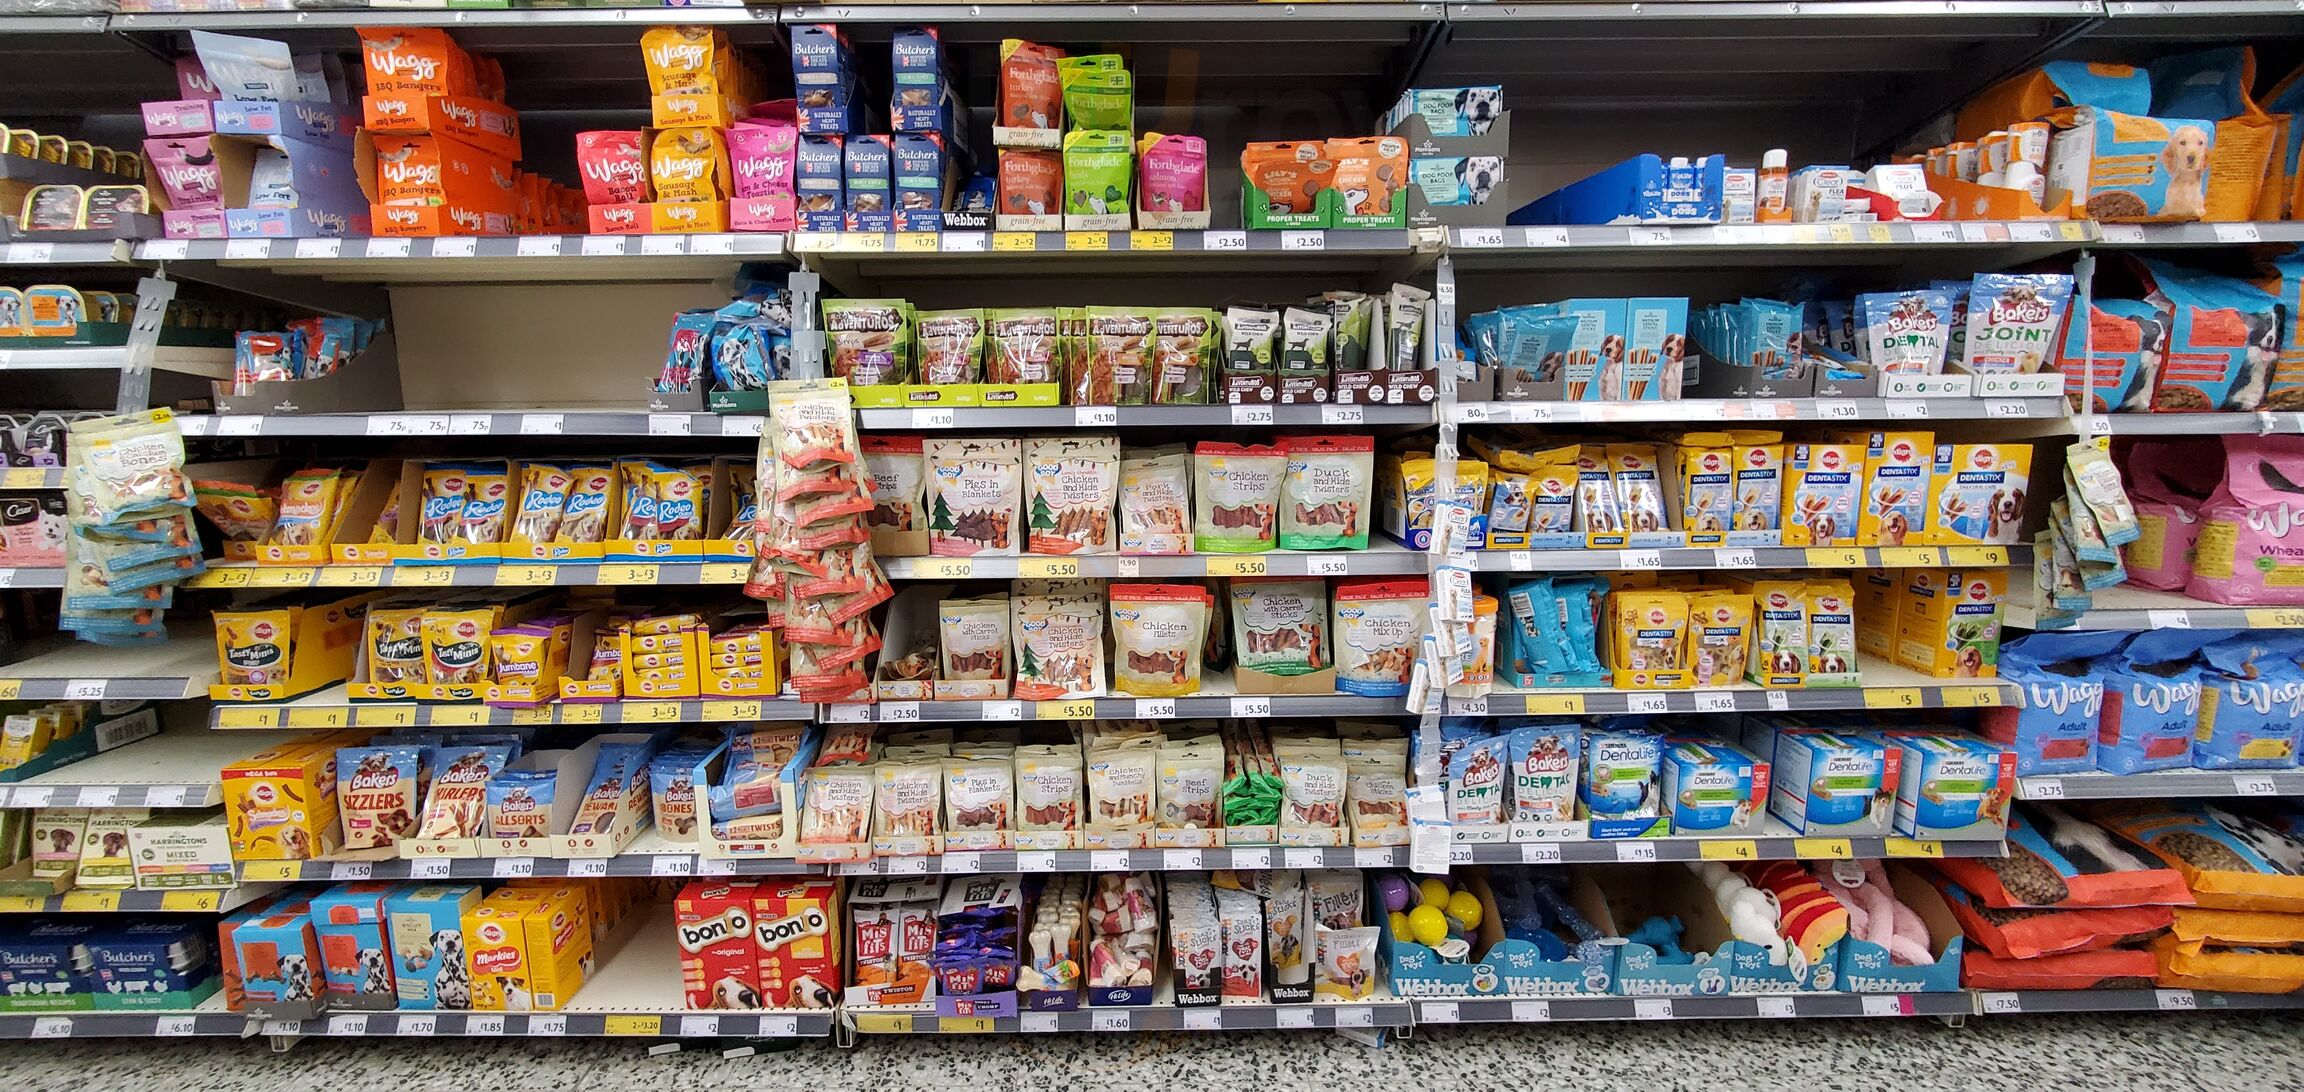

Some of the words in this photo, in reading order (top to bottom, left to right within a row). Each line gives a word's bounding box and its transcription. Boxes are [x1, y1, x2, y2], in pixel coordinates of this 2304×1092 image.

[795, 45, 836, 55] Butcher's
[896, 45, 935, 56] Butcher's
[650, 45, 708, 69] Wagg
[371, 51, 441, 80] Wagg
[662, 72, 696, 83] Sausage
[397, 82, 442, 92] Bangers
[377, 100, 407, 115] Wagg
[667, 99, 698, 114] Wagg
[295, 105, 336, 131] Wagg
[441, 99, 478, 127] Wagg
[147, 111, 177, 127] Wagg
[1008, 130, 1044, 140] grain-free
[800, 152, 839, 163] Butcher's
[848, 152, 888, 162] Butcher's
[898, 150, 938, 160] Butcher's
[1069, 155, 1123, 168] Forthglade
[1149, 158, 1201, 174] Forthglade
[586, 157, 644, 184] Wagg
[652, 156, 708, 180] Wagg
[738, 156, 788, 180] Wagg
[163, 166, 216, 192] Wagg
[608, 187, 637, 195] Bacon
[658, 182, 695, 191] Sausage
[667, 207, 698, 223] Wagg
[749, 203, 775, 217] Wagg
[388, 209, 419, 224] Wagg
[450, 207, 482, 231] Wagg
[603, 208, 635, 224] Wagg
[944, 213, 986, 227] Webbox
[1010, 217, 1047, 226] grain-free
[1082, 217, 1119, 226] grain-free
[1157, 215, 1194, 225] grain-free
[1267, 215, 1292, 223] PROPER
[861, 238, 882, 247] £1.75
[1219, 237, 1245, 247] £2.50
[1477, 235, 1501, 245] £1.65
[1652, 232, 1670, 243] 75p
[1991, 305, 2050, 322] Bakers
[1890, 316, 1937, 331] Bakers
[1467, 409, 1485, 418] 80p
[1833, 407, 1855, 417] £1.30
[2000, 405, 2025, 416] £2.20
[931, 415, 951, 425] £1.10
[1247, 412, 1271, 422] £2.75
[1229, 470, 1269, 481] Chicken
[1314, 468, 1350, 478] Duck
[1738, 470, 1775, 479] DENTASTIX
[1881, 467, 1919, 476] DENTASTIX
[874, 474, 899, 483] Beef
[1062, 476, 1099, 484] Chicken
[1693, 475, 1729, 483] DENTASTIX
[1808, 474, 1850, 483] DENTASTIX
[1960, 473, 2003, 482] DENTASTIX
[965, 480, 988, 491] Pigs
[989, 480, 999, 489] in
[1079, 483, 1098, 491] Hide
[1233, 482, 1265, 491] Strips
[1314, 485, 1350, 493] Twisters
[962, 489, 1001, 499] Blankets
[1063, 491, 1100, 500] Twisters
[527, 491, 562, 511] Rodeo
[566, 493, 604, 513] Rodeo
[659, 502, 691, 521] Rodeo
[1637, 557, 1660, 567] £1.65
[1733, 555, 1755, 566] £1.65
[1845, 554, 1856, 565] £5
[1986, 552, 1998, 563] £9
[941, 566, 970, 577] £5.50
[1047, 564, 1076, 575] £5.50
[1236, 562, 1265, 574] £5.50
[1322, 562, 1346, 573] £5.50
[1263, 597, 1301, 607] Chicken
[1279, 604, 1304, 613] Carrot
[1957, 605, 1993, 614] DENTASTIX
[1364, 619, 1411, 629] Chicken
[1813, 615, 1849, 624] DENTASTIX
[964, 622, 996, 630] Chicken
[1143, 622, 1187, 632] Chicken
[1705, 627, 1741, 636] DENTASTIX
[1048, 628, 1084, 636] Chicken
[1153, 630, 1176, 638] Fillets
[1373, 626, 1389, 636] Mix
[1390, 628, 1403, 638] Up
[1640, 630, 1674, 639] DENTASTIX
[78, 686, 101, 698] £5.25
[1643, 699, 1665, 711] £1.65
[1711, 697, 1733, 709] £1.65
[2031, 681, 2103, 718] Wagg
[893, 708, 918, 720] £2.50
[1064, 705, 1092, 717] £5.50
[1150, 706, 1174, 717] £5.50
[1245, 704, 1269, 715] £5.50
[1462, 703, 1485, 714] £4.30
[2058, 720, 2088, 733] Adult
[2161, 720, 2188, 732] Adult
[2261, 722, 2291, 732] Adult
[1600, 747, 1654, 762] DentaLife
[1528, 754, 1569, 772] Bakers
[1828, 761, 1873, 773] DentaLife
[440, 767, 488, 783] Bakers
[1465, 763, 1500, 787] Bakers
[1940, 765, 1987, 776] DentaLife
[352, 772, 398, 789] Bakers
[1038, 776, 1072, 785] Chicken
[1694, 774, 1734, 786] DentaLife
[897, 782, 928, 791] Chicken
[1041, 785, 1069, 793] Strips
[501, 800, 534, 812] Bakers
[660, 803, 692, 814] BONES
[496, 814, 545, 826] ALLSORTS
[750, 821, 780, 832] TWISTS
[151, 836, 208, 846] HARRINGTONS
[166, 850, 197, 860] MIXED
[1635, 849, 1654, 859] £1.15
[348, 865, 370, 877] £1.50
[427, 865, 448, 876] £1.50
[197, 897, 208, 909] £6
[1191, 936, 1217, 948] Sticks
[2, 951, 58, 964] Butcher's
[103, 950, 155, 963] Butcher's
[477, 950, 517, 965] Markies
[716, 948, 745, 957] original
[1402, 961, 1423, 971] Toys
[1396, 978, 1468, 996] Webbox
[1504, 977, 1577, 993] Webbox
[1621, 979, 1692, 996] Webbox
[1731, 976, 1804, 993] Webbox
[1848, 976, 1925, 993] Webbox
[1178, 993, 1217, 1005] Webbox
[1274, 988, 1310, 999] Webbox
[1997, 998, 2019, 1010] £7.50
[2169, 995, 2194, 1007] £9.50
[411, 1021, 432, 1033] £1.70
[481, 1021, 501, 1032] £1.85
[1106, 1018, 1128, 1029] £1.60
[49, 1024, 70, 1035] £6.10
